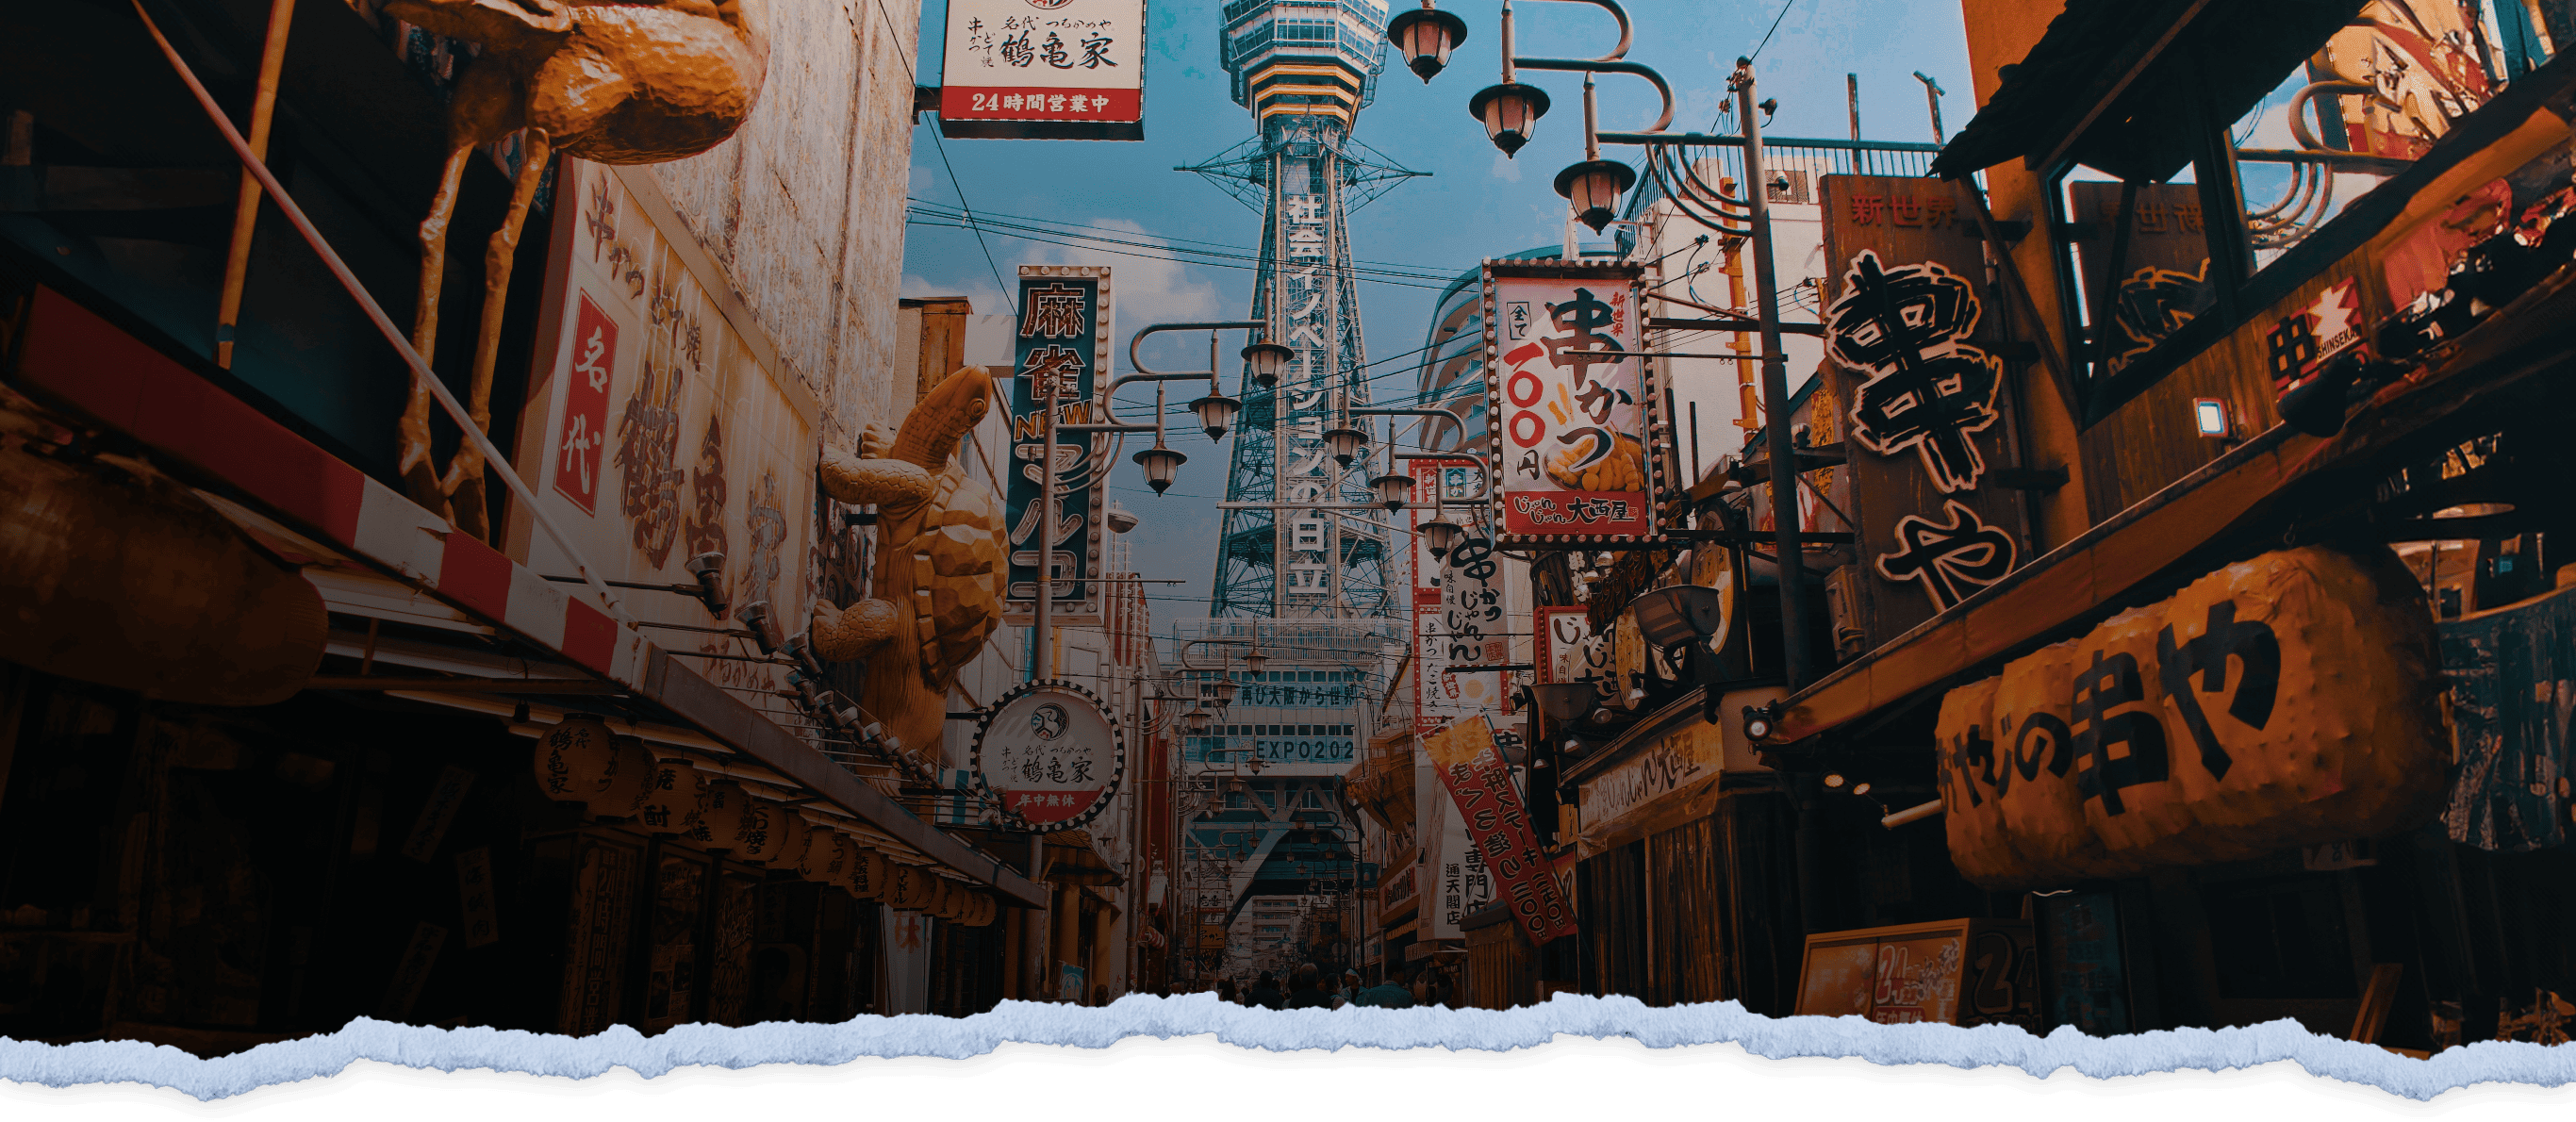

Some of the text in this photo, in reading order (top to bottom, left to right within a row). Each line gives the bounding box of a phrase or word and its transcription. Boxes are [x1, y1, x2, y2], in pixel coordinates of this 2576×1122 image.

[967, 17, 983, 52] 串かつ
[1000, 16, 1039, 31] 名代
[999, 30, 1118, 69] 鶴亀家
[971, 92, 1110, 113] 24時間営業中
[1851, 194, 1957, 226] 新世界
[1509, 304, 1528, 338] 全て
[1609, 291, 1626, 338] 新世界
[1018, 282, 1086, 402] 麻雀
[1288, 194, 1329, 594] 社会イノベーションの日立
[1541, 288, 1633, 472] 串かつ
[563, 326, 610, 495] 名代
[1566, 496, 1637, 525] 大西屋
[1444, 570, 1457, 605] 味自慢
[1241, 685, 1355, 706] 再び大阪から世界
[548, 727, 574, 794] 鶴亀家
[1022, 754, 1096, 784] 鶴亀家
[1018, 793, 1076, 808] 年中無休
[1445, 862, 1461, 925] 通天閣店
